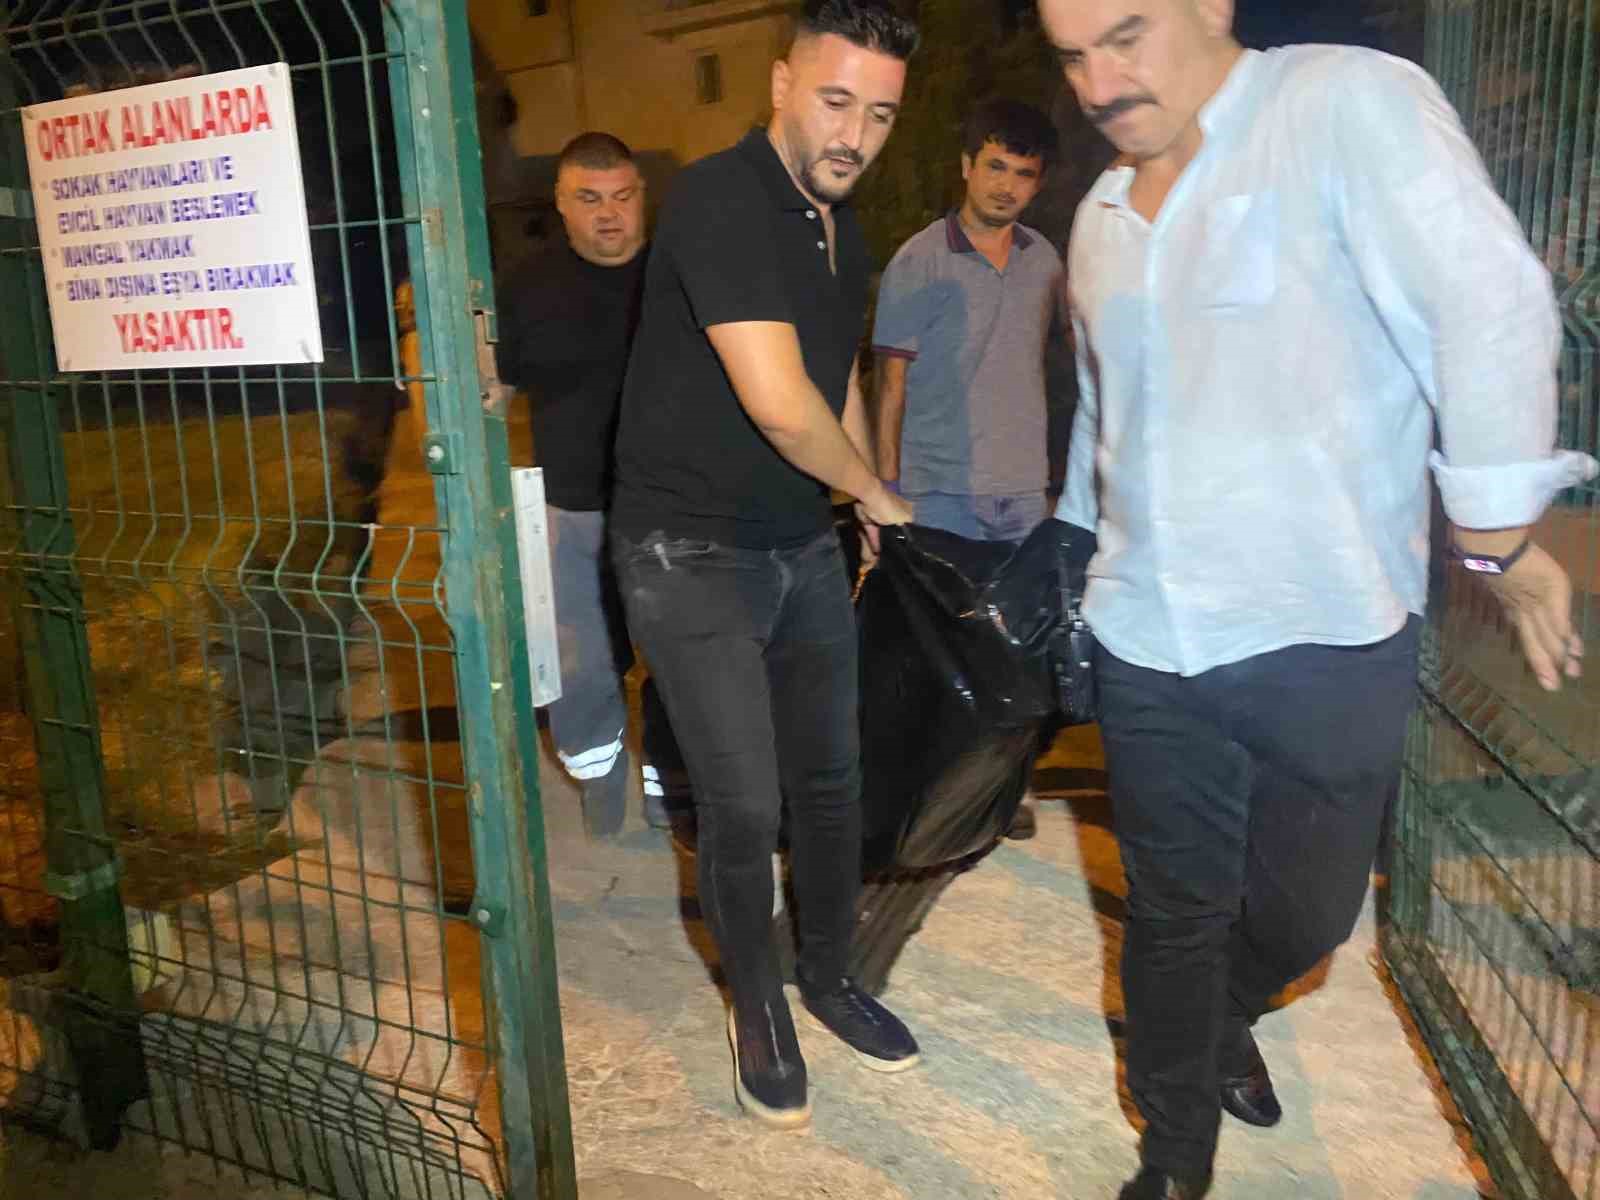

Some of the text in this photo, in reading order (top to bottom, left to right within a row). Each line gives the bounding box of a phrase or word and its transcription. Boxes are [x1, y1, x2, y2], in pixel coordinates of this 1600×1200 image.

[36, 84, 273, 161] ORTAK ALANLARDA
[51, 155, 234, 200] SOKAK HAYVANLARI VE
[102, 201, 167, 230] HAYVAN
[171, 190, 261, 223] BESLEMEK
[62, 235, 194, 268] MANGAL YAKMAK
[104, 273, 160, 304] DIŞINA
[160, 270, 203, 300] EŞYA
[206, 262, 298, 292] BIRAKMAK
[113, 307, 244, 353] YASAKTIR.
